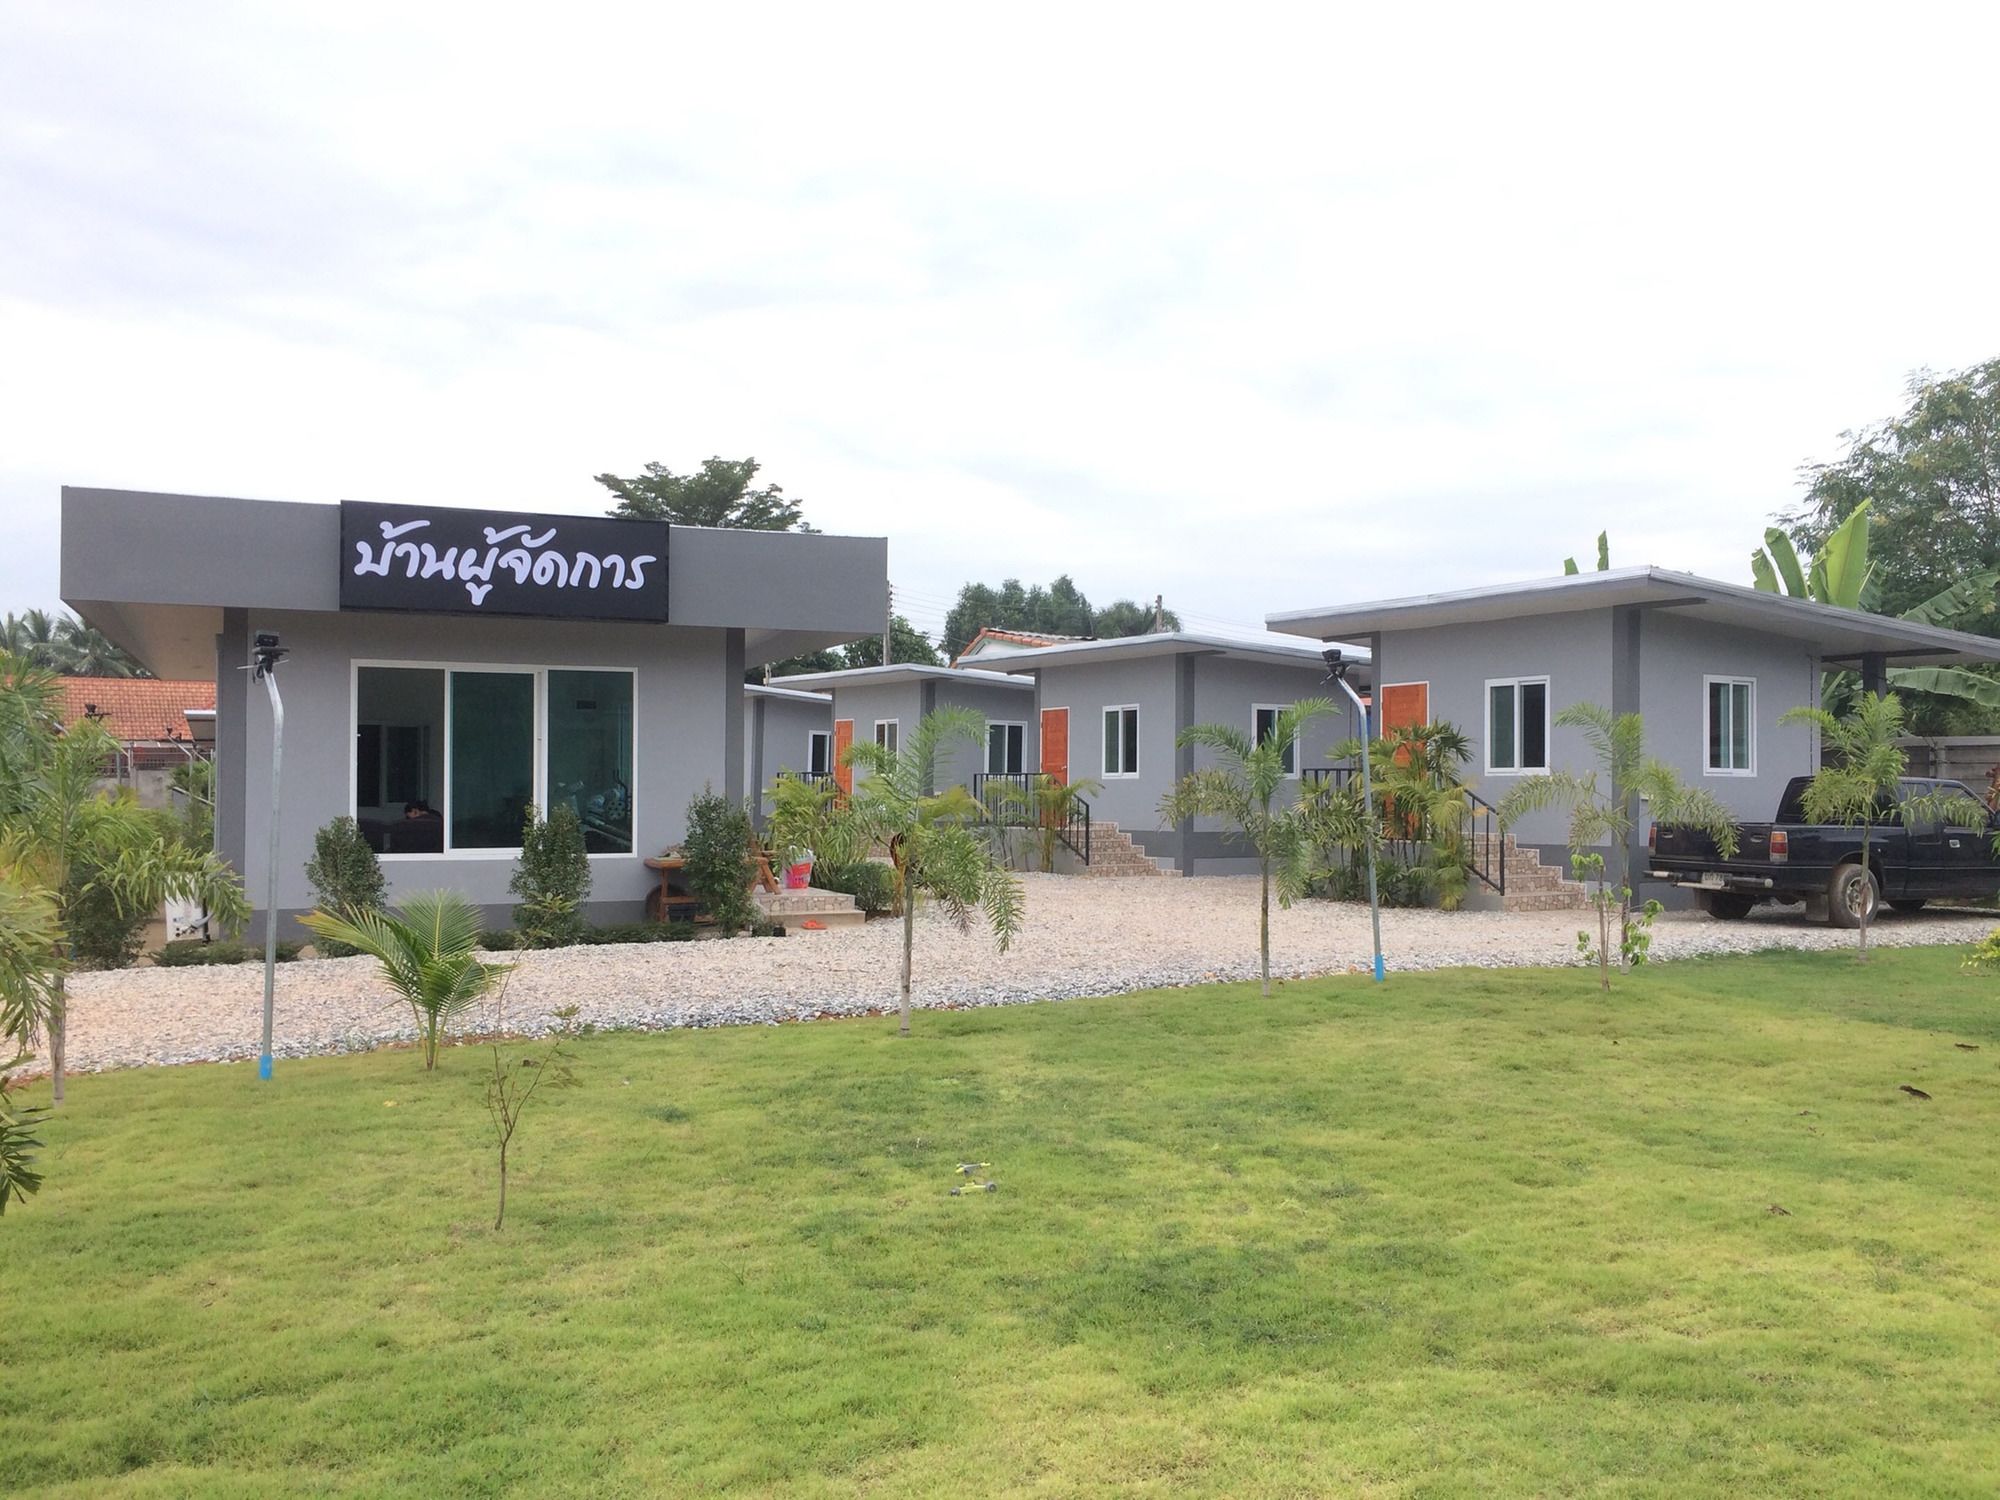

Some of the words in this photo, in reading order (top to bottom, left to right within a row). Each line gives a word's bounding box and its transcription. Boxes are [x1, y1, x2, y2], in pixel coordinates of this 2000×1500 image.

[354, 519, 657, 606] บ้านผู้จัดการ
